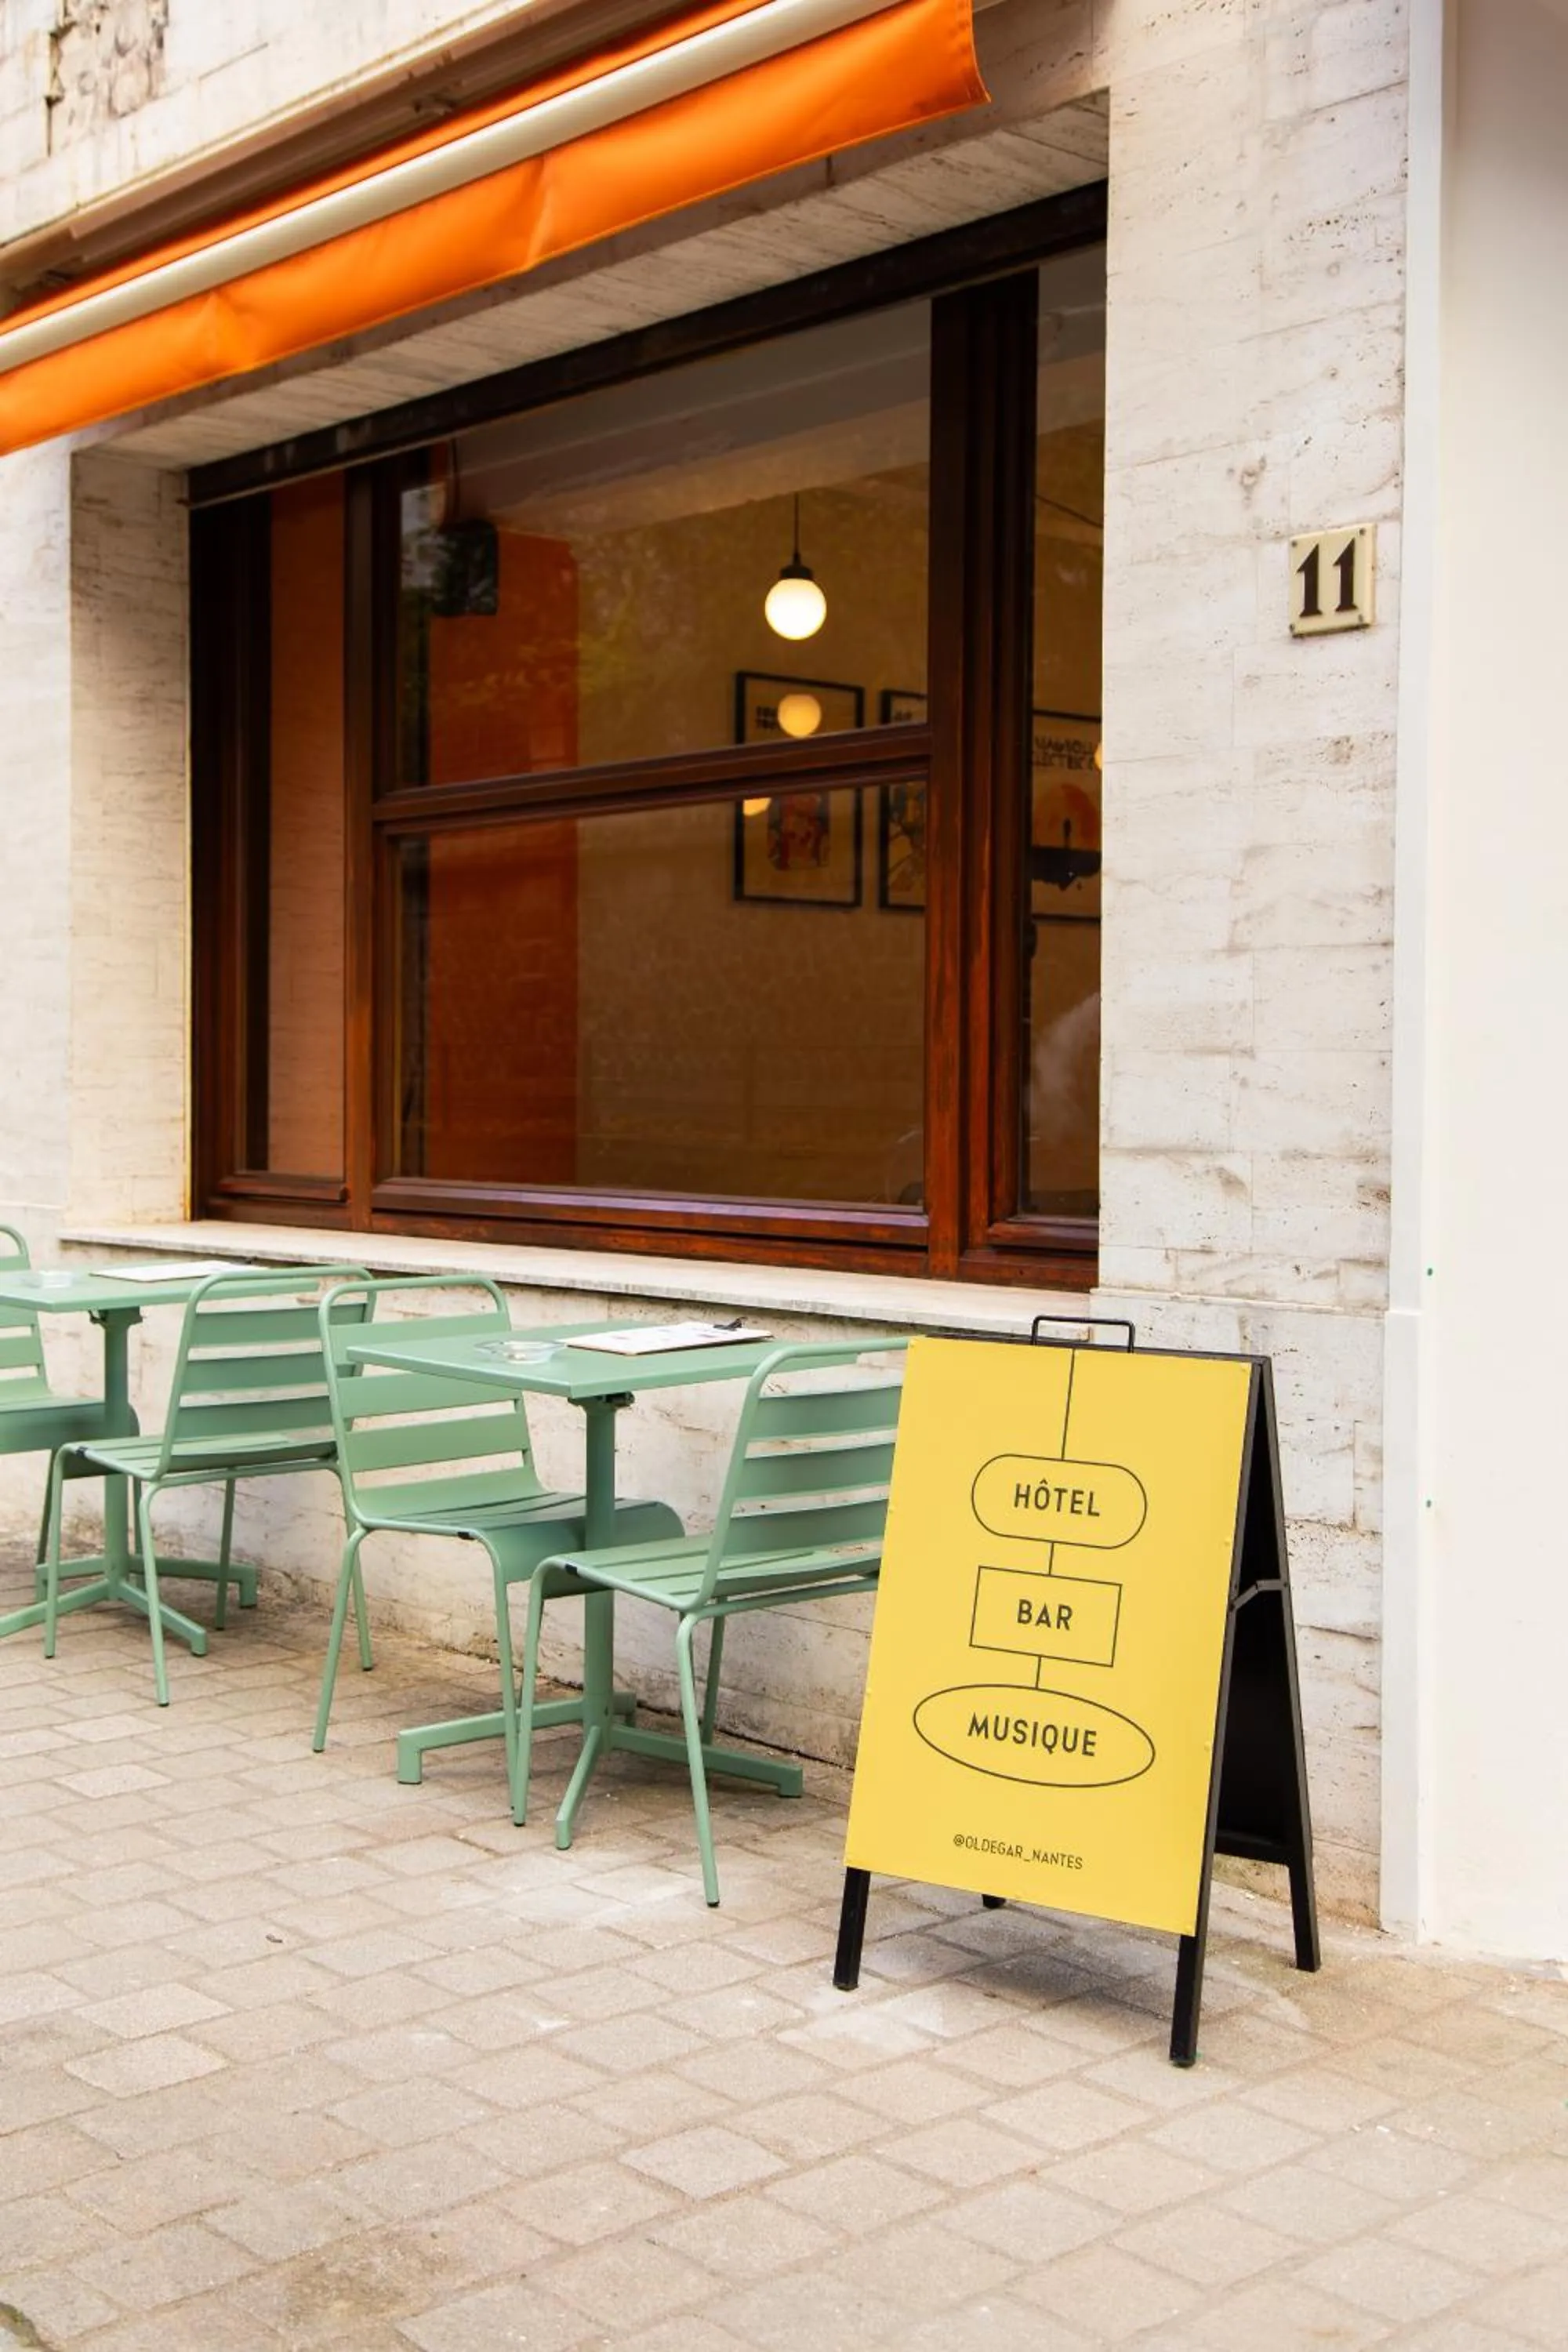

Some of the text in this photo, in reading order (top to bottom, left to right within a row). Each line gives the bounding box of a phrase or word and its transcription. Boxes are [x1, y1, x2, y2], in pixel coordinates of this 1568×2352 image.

[1296, 537, 1359, 618] 11
[1013, 1479, 1101, 1517] HÔTEL
[1016, 1599, 1073, 1631] BAR
[967, 1712, 1098, 1757] MUSIQUE
[953, 1833, 1083, 1870] @OLDEGAR_NANTES
